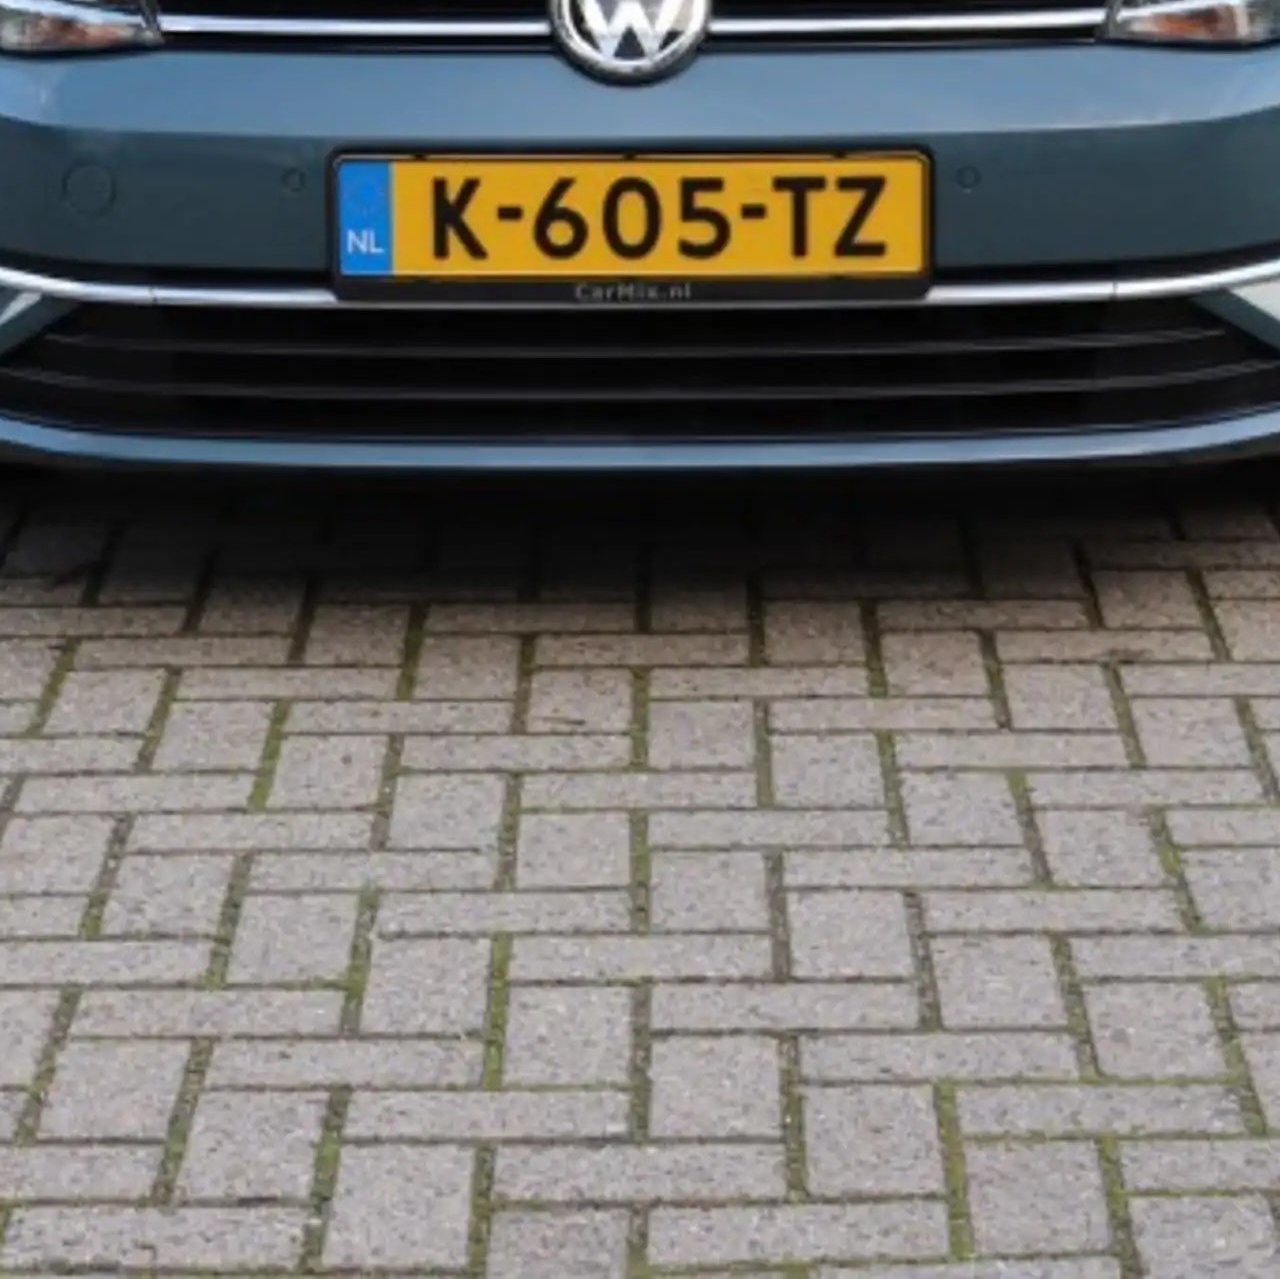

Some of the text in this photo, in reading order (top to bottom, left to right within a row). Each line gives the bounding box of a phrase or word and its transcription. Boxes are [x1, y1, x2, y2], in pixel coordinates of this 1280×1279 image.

[346, 177, 887, 260] NL K-605-TZ
[575, 281, 692, 300] CarMix.nl
